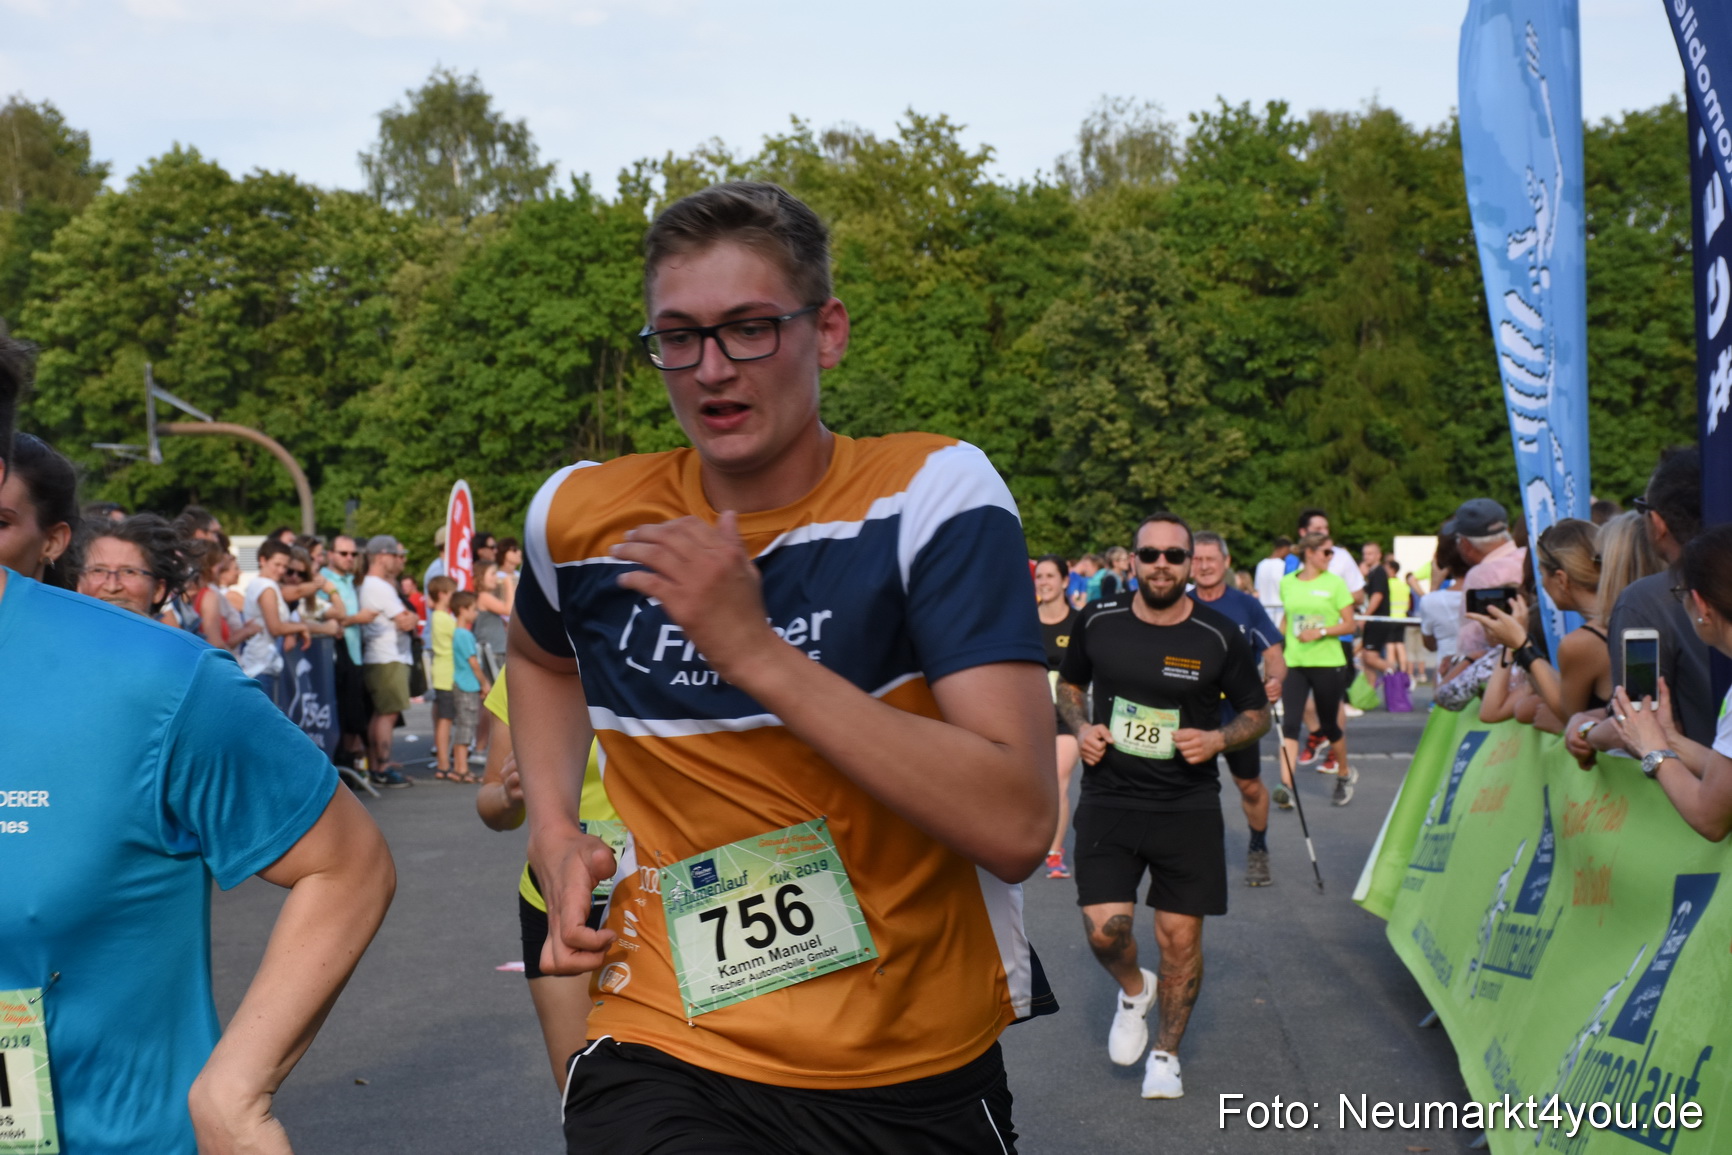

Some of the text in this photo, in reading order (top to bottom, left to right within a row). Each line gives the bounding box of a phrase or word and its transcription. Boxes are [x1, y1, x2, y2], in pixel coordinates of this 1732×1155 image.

[652, 609, 832, 662] Fier
[1124, 721, 1160, 744] 128
[795, 859, 829, 878] 2019
[698, 883, 815, 962] 756
[709, 976, 746, 995] Fischer
[749, 956, 806, 983] Automobile
[807, 945, 839, 963] GmbH
[717, 956, 766, 979] Kamm
[768, 934, 822, 963] Manuel
